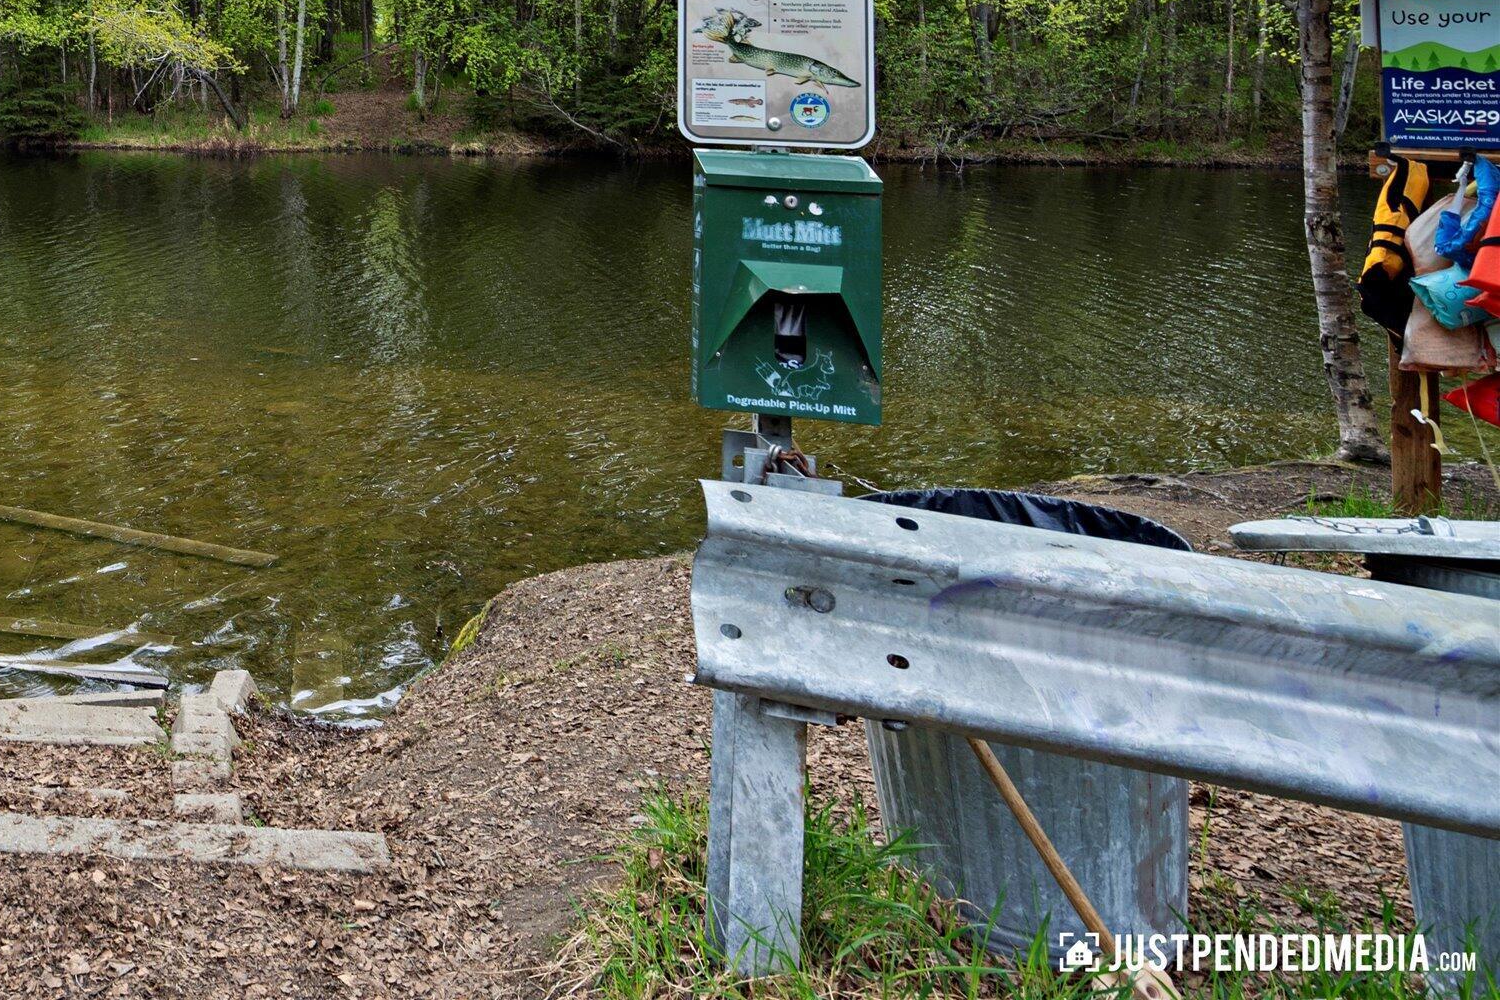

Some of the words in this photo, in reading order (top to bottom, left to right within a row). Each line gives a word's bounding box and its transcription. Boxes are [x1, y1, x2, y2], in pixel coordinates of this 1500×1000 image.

[1392, 10, 1430, 25] Use
[1438, 11, 1491, 28] your
[1391, 77, 1425, 90] Life
[1431, 77, 1496, 90] Jacket
[1393, 109, 1500, 125] ALASKA529
[741, 216, 793, 243] Mutt
[793, 219, 842, 246] Mitt
[727, 394, 786, 409] Degradable
[789, 401, 831, 414] Pick-Up
[833, 404, 857, 416] Mitt
